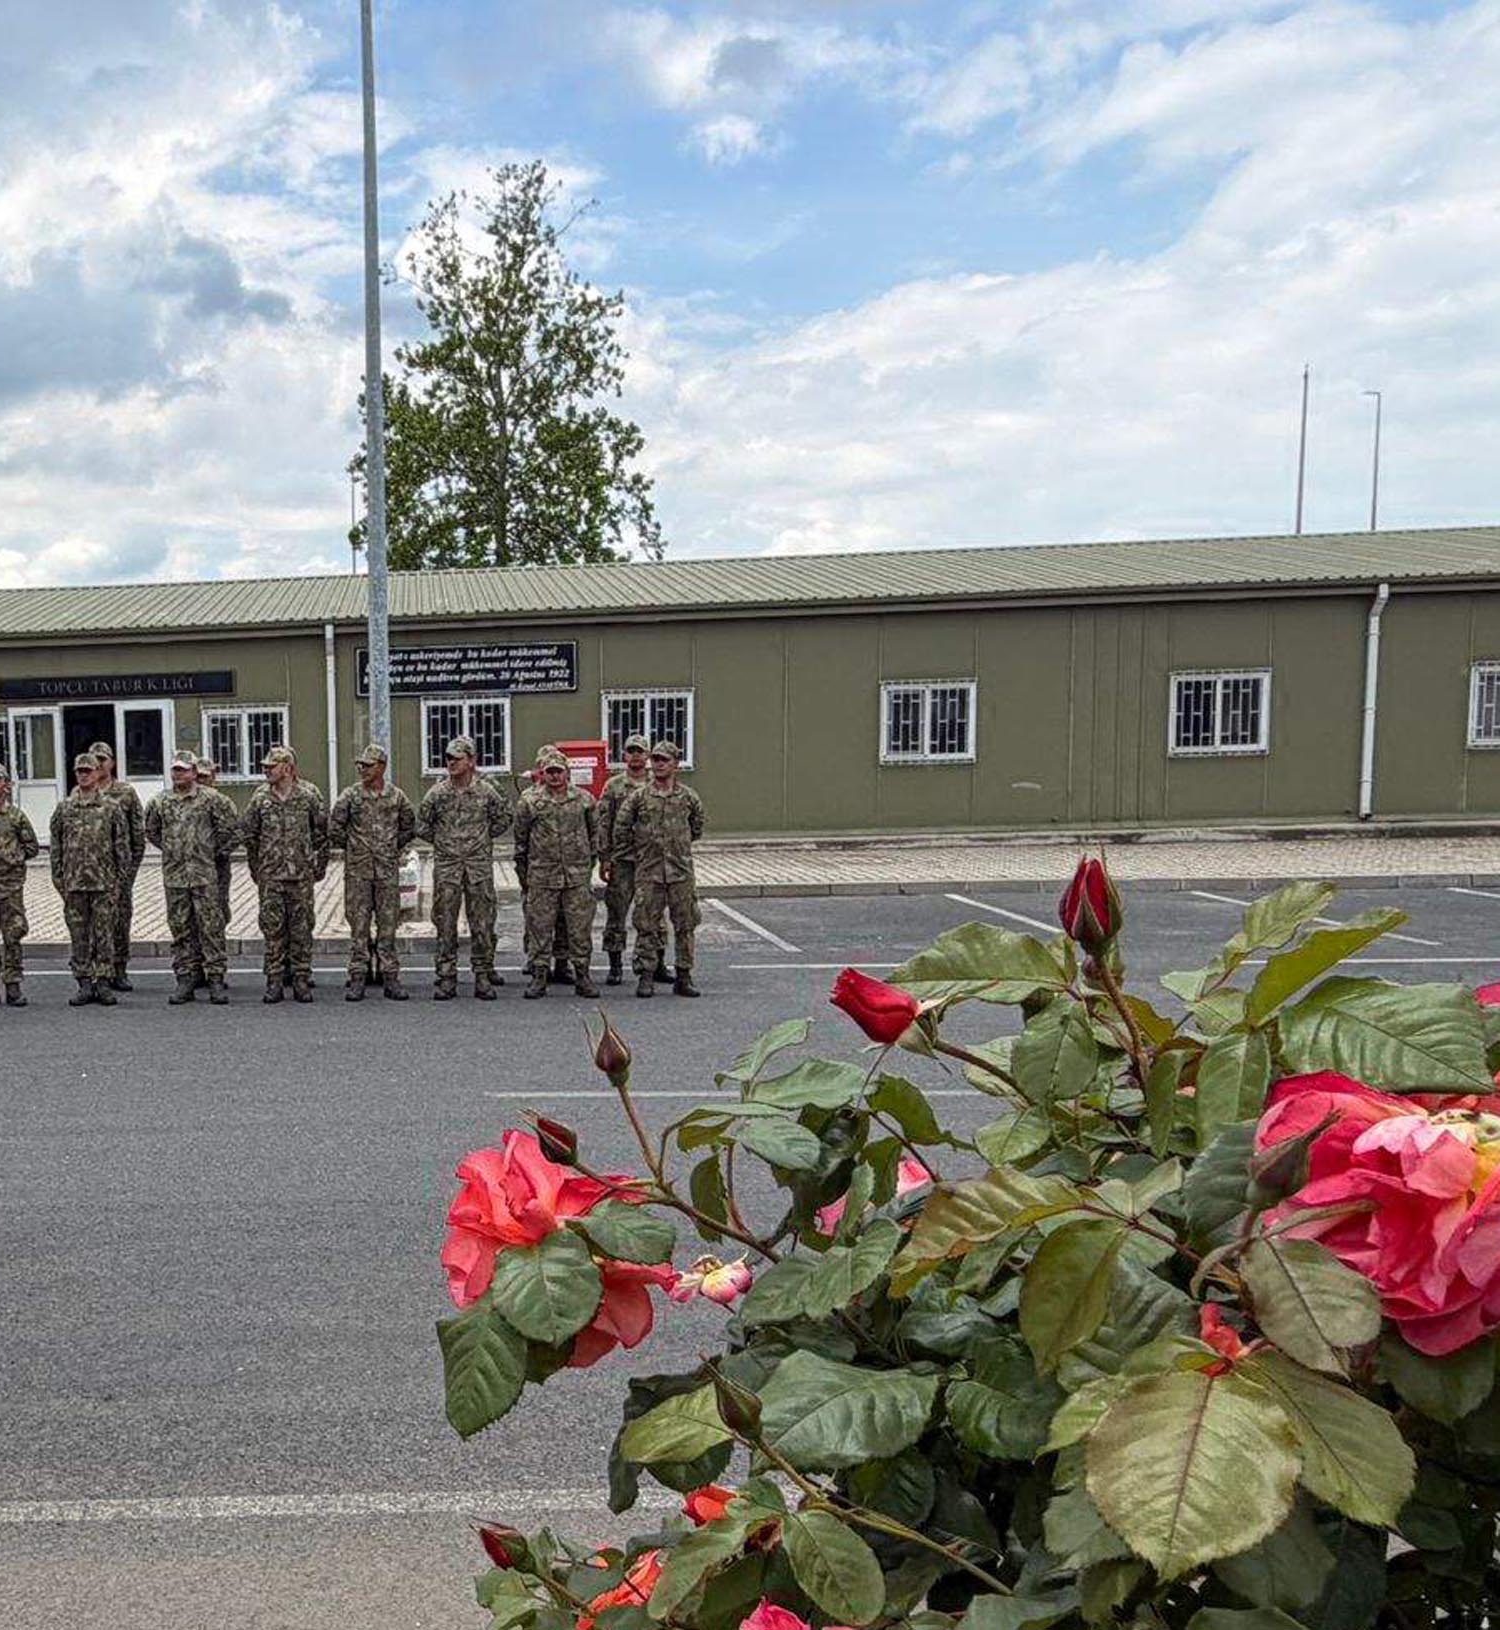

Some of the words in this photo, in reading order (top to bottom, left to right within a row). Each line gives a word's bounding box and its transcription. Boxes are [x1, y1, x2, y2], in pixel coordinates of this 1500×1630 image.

[467, 649, 479, 658] bu
[480, 648, 507, 658] kadar
[417, 663, 428, 671] bu
[430, 662, 457, 671] kadar
[510, 659, 532, 668] idare
[548, 669, 570, 678] 1922
[92, 678, 145, 694] TABUR
